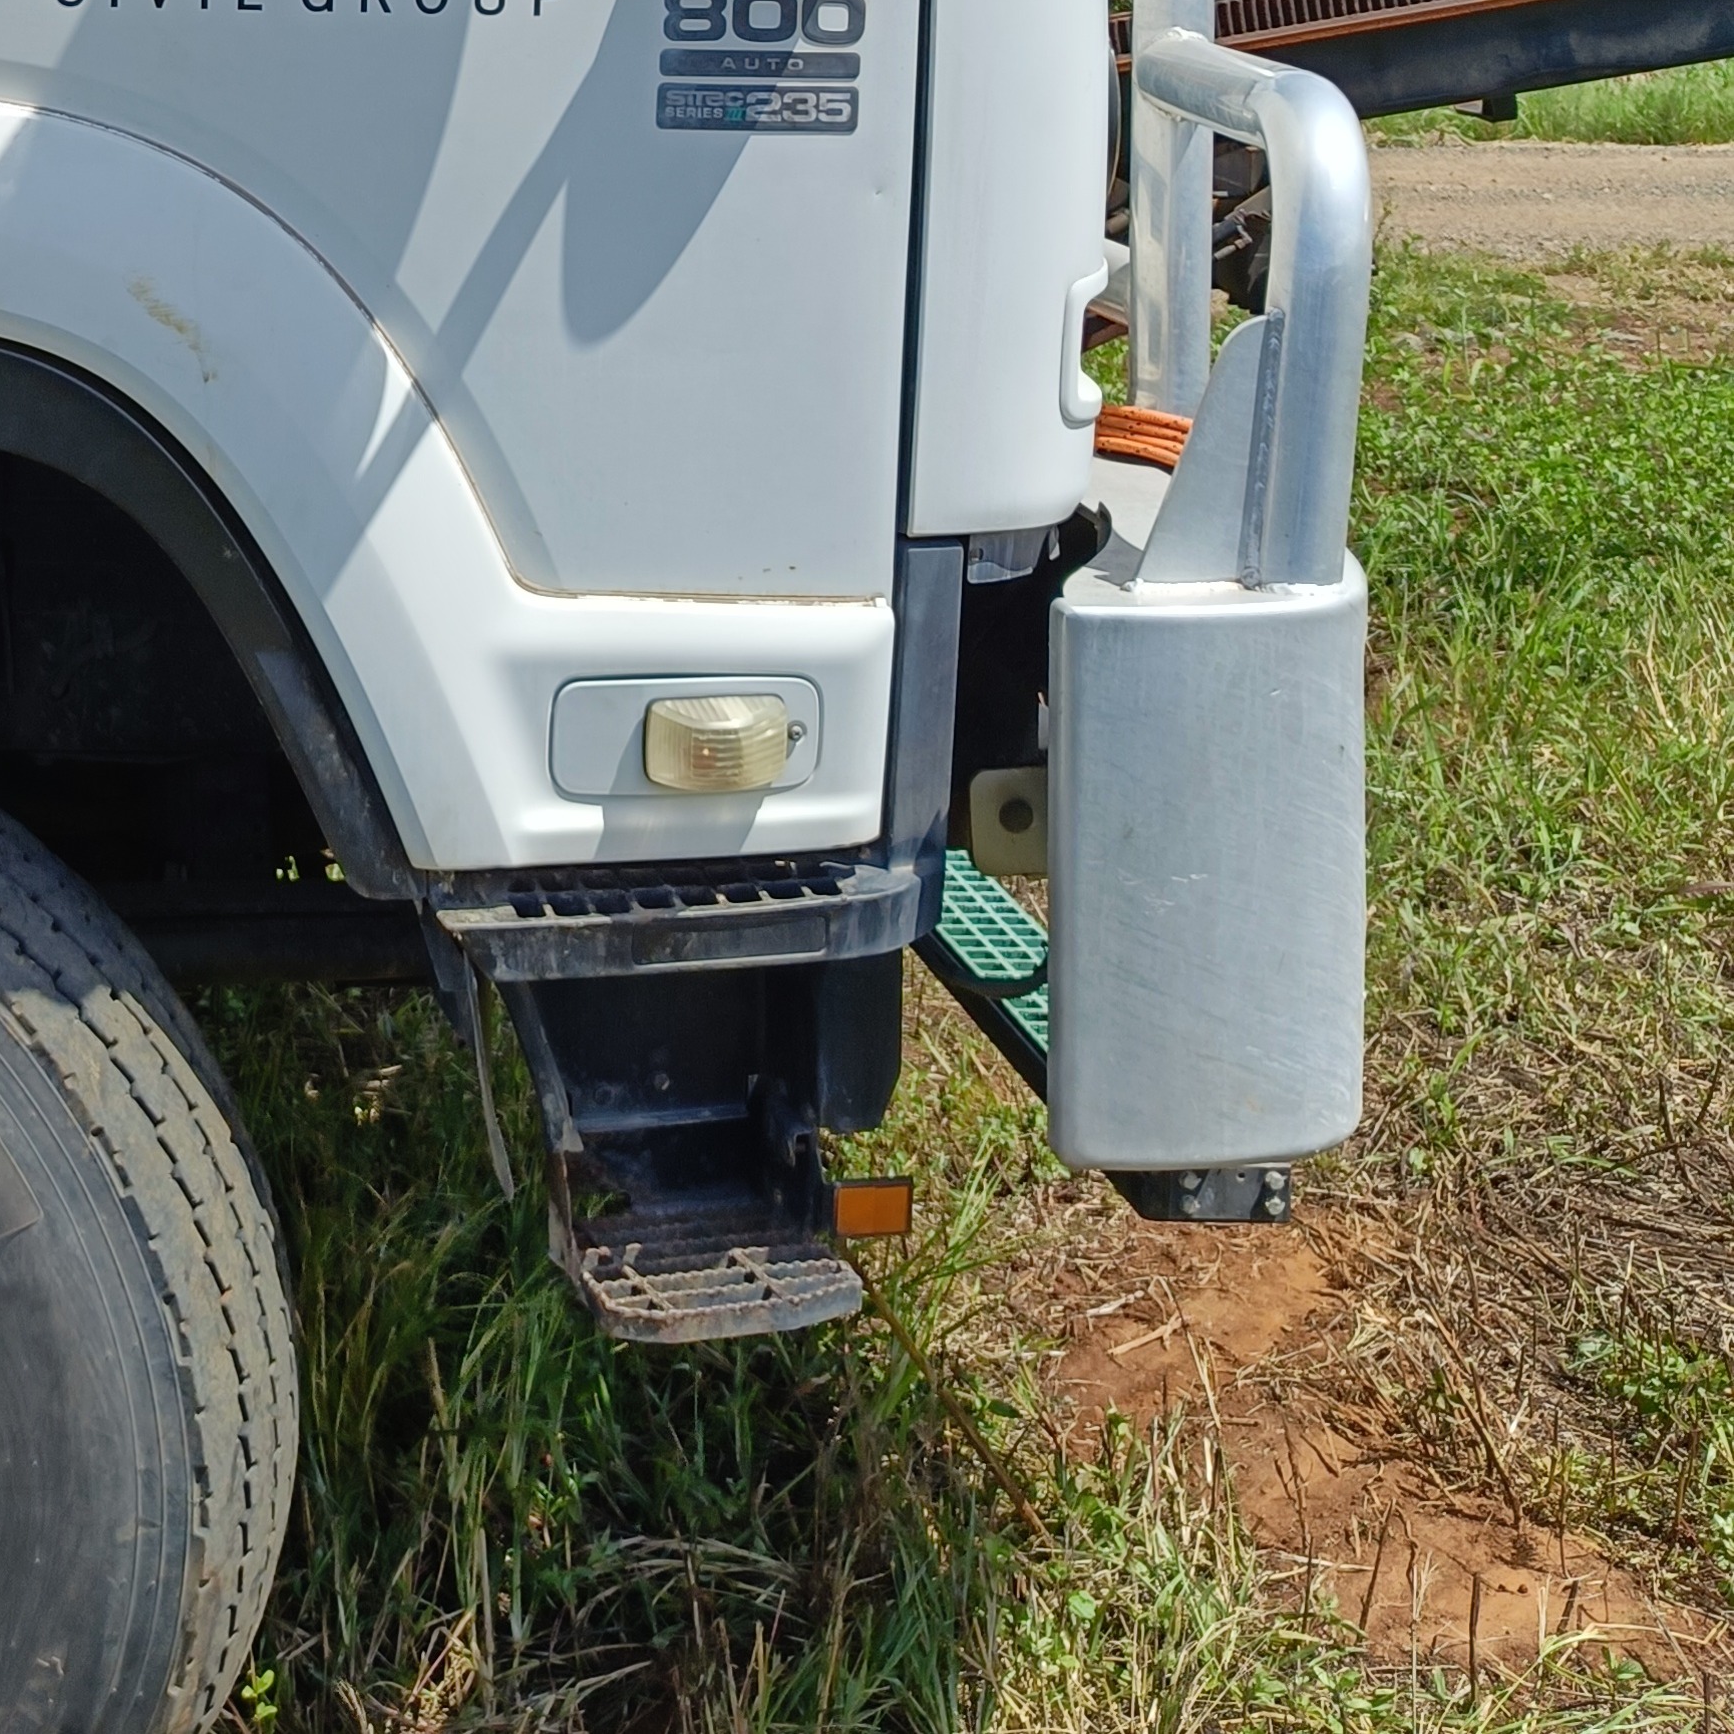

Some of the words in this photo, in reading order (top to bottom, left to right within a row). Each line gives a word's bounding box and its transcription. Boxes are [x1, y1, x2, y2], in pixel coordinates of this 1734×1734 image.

[720, 55, 805, 71] AUTO
[665, 107, 724, 119] SERIES
[746, 91, 852, 123] 235
